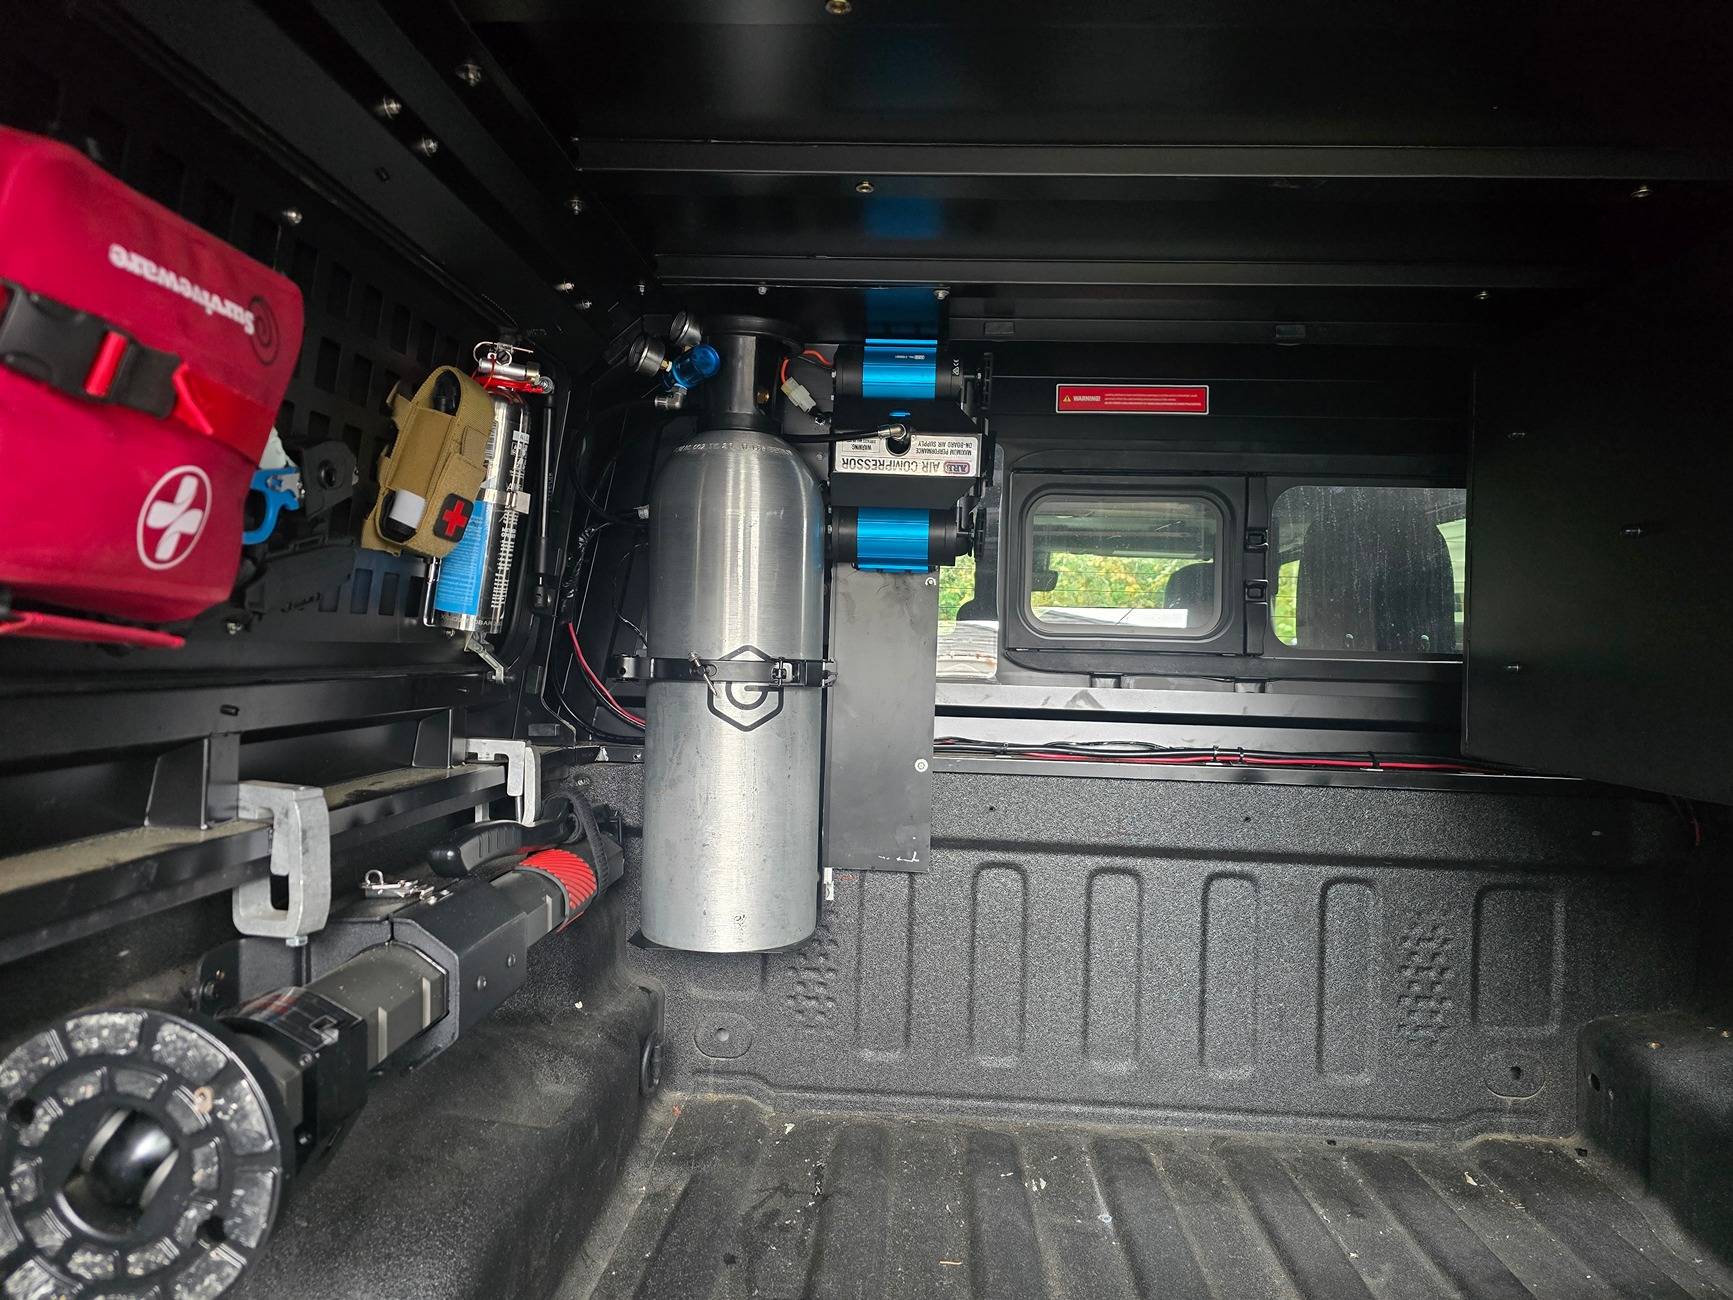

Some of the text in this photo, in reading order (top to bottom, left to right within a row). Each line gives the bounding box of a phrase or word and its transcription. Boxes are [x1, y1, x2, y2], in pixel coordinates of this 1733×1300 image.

[108, 244, 255, 336] Surviveware
[947, 441, 973, 449] ON-BOARD
[916, 447, 973, 456] MAXIMUM PERFORMANCE
[841, 457, 918, 472] COMPRESSOR
[921, 461, 940, 473] AIR
